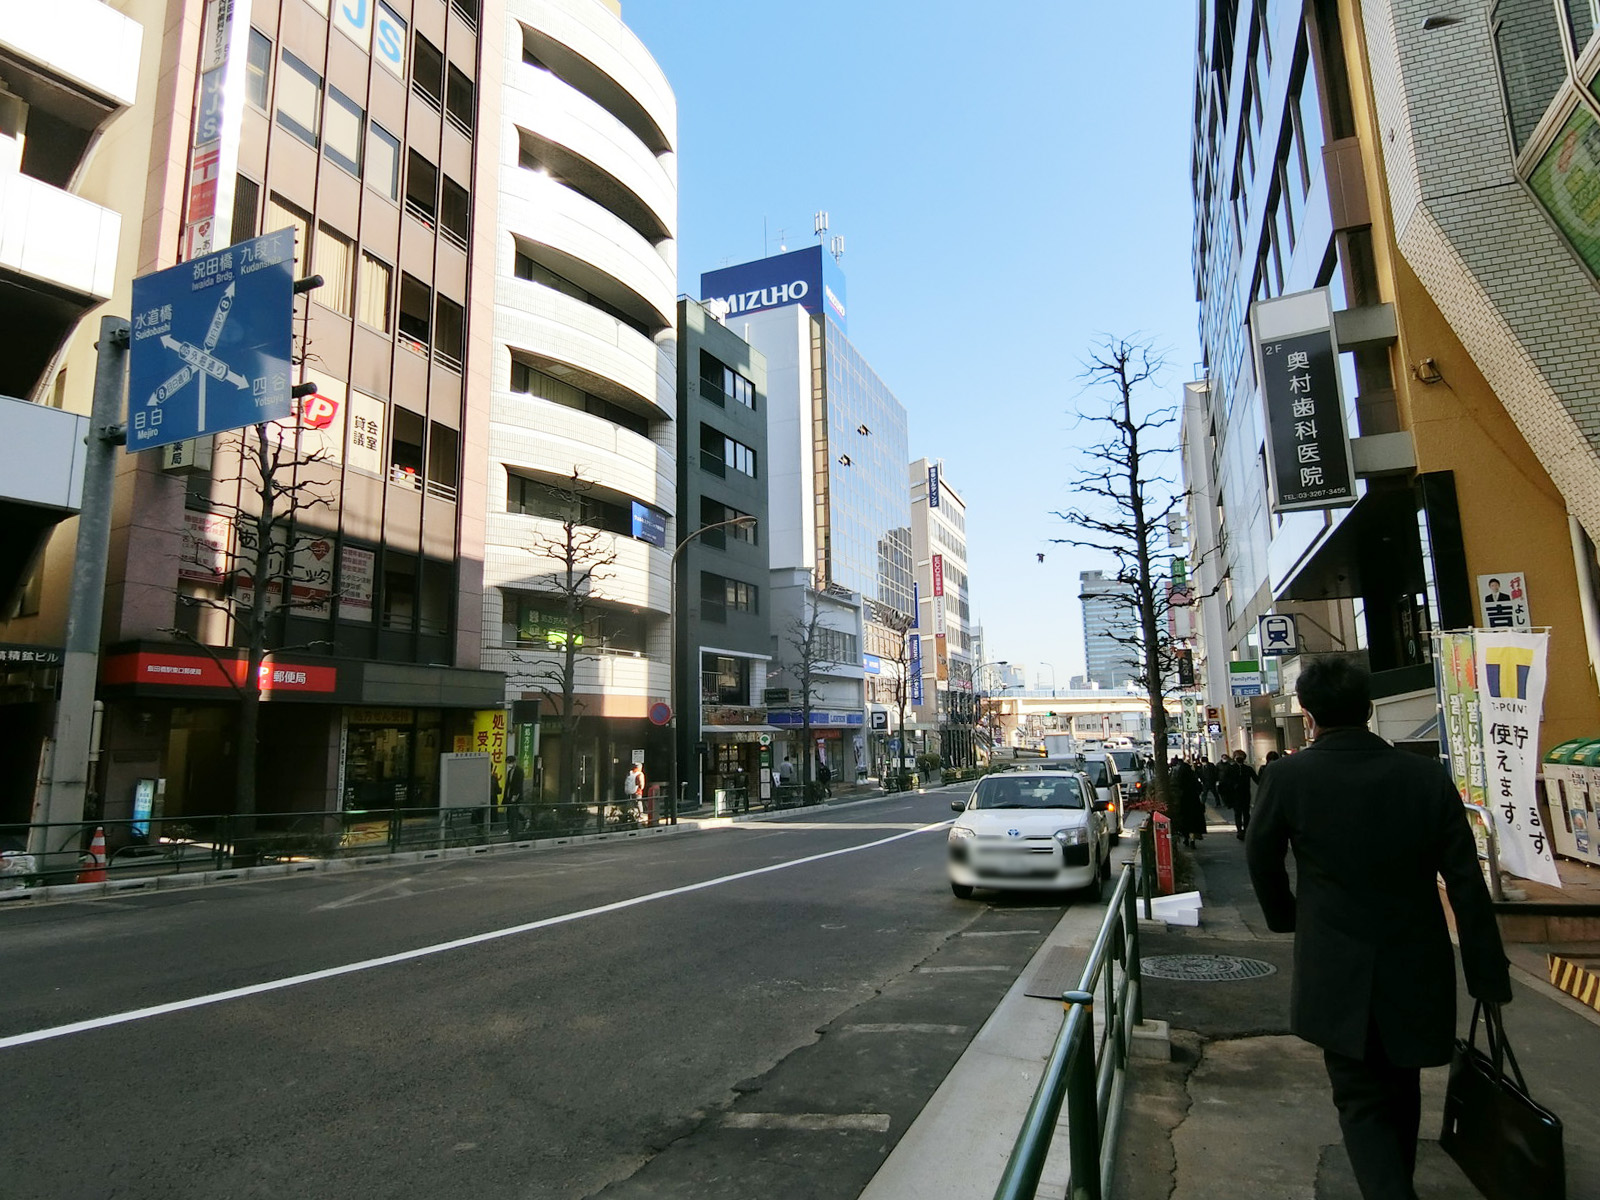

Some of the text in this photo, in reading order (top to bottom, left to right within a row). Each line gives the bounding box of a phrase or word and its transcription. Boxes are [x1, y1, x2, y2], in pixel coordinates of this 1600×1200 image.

[193, 235, 283, 280] 祝田橋 九段下
[191, 256, 282, 292] Iwaida Brdg. Kudanshita
[722, 280, 809, 314] MIZUHO
[134, 303, 174, 330] 水道橋
[135, 322, 172, 341] Suidobashi
[191, 349, 226, 376] 外堀通り
[166, 367, 191, 393] 目白通り
[253, 372, 287, 396] 四谷
[158, 388, 165, 399] 8
[254, 395, 285, 408] Yotsuya
[135, 408, 163, 430] 目白
[1286, 350, 1324, 488] 奥村歯科医院
[137, 428, 159, 441] Mejiro
[273, 670, 307, 685] 郵便局
[1208, 708, 1218, 718] P
[1491, 702, 1528, 715] T-POINT
[872, 713, 886, 729] P
